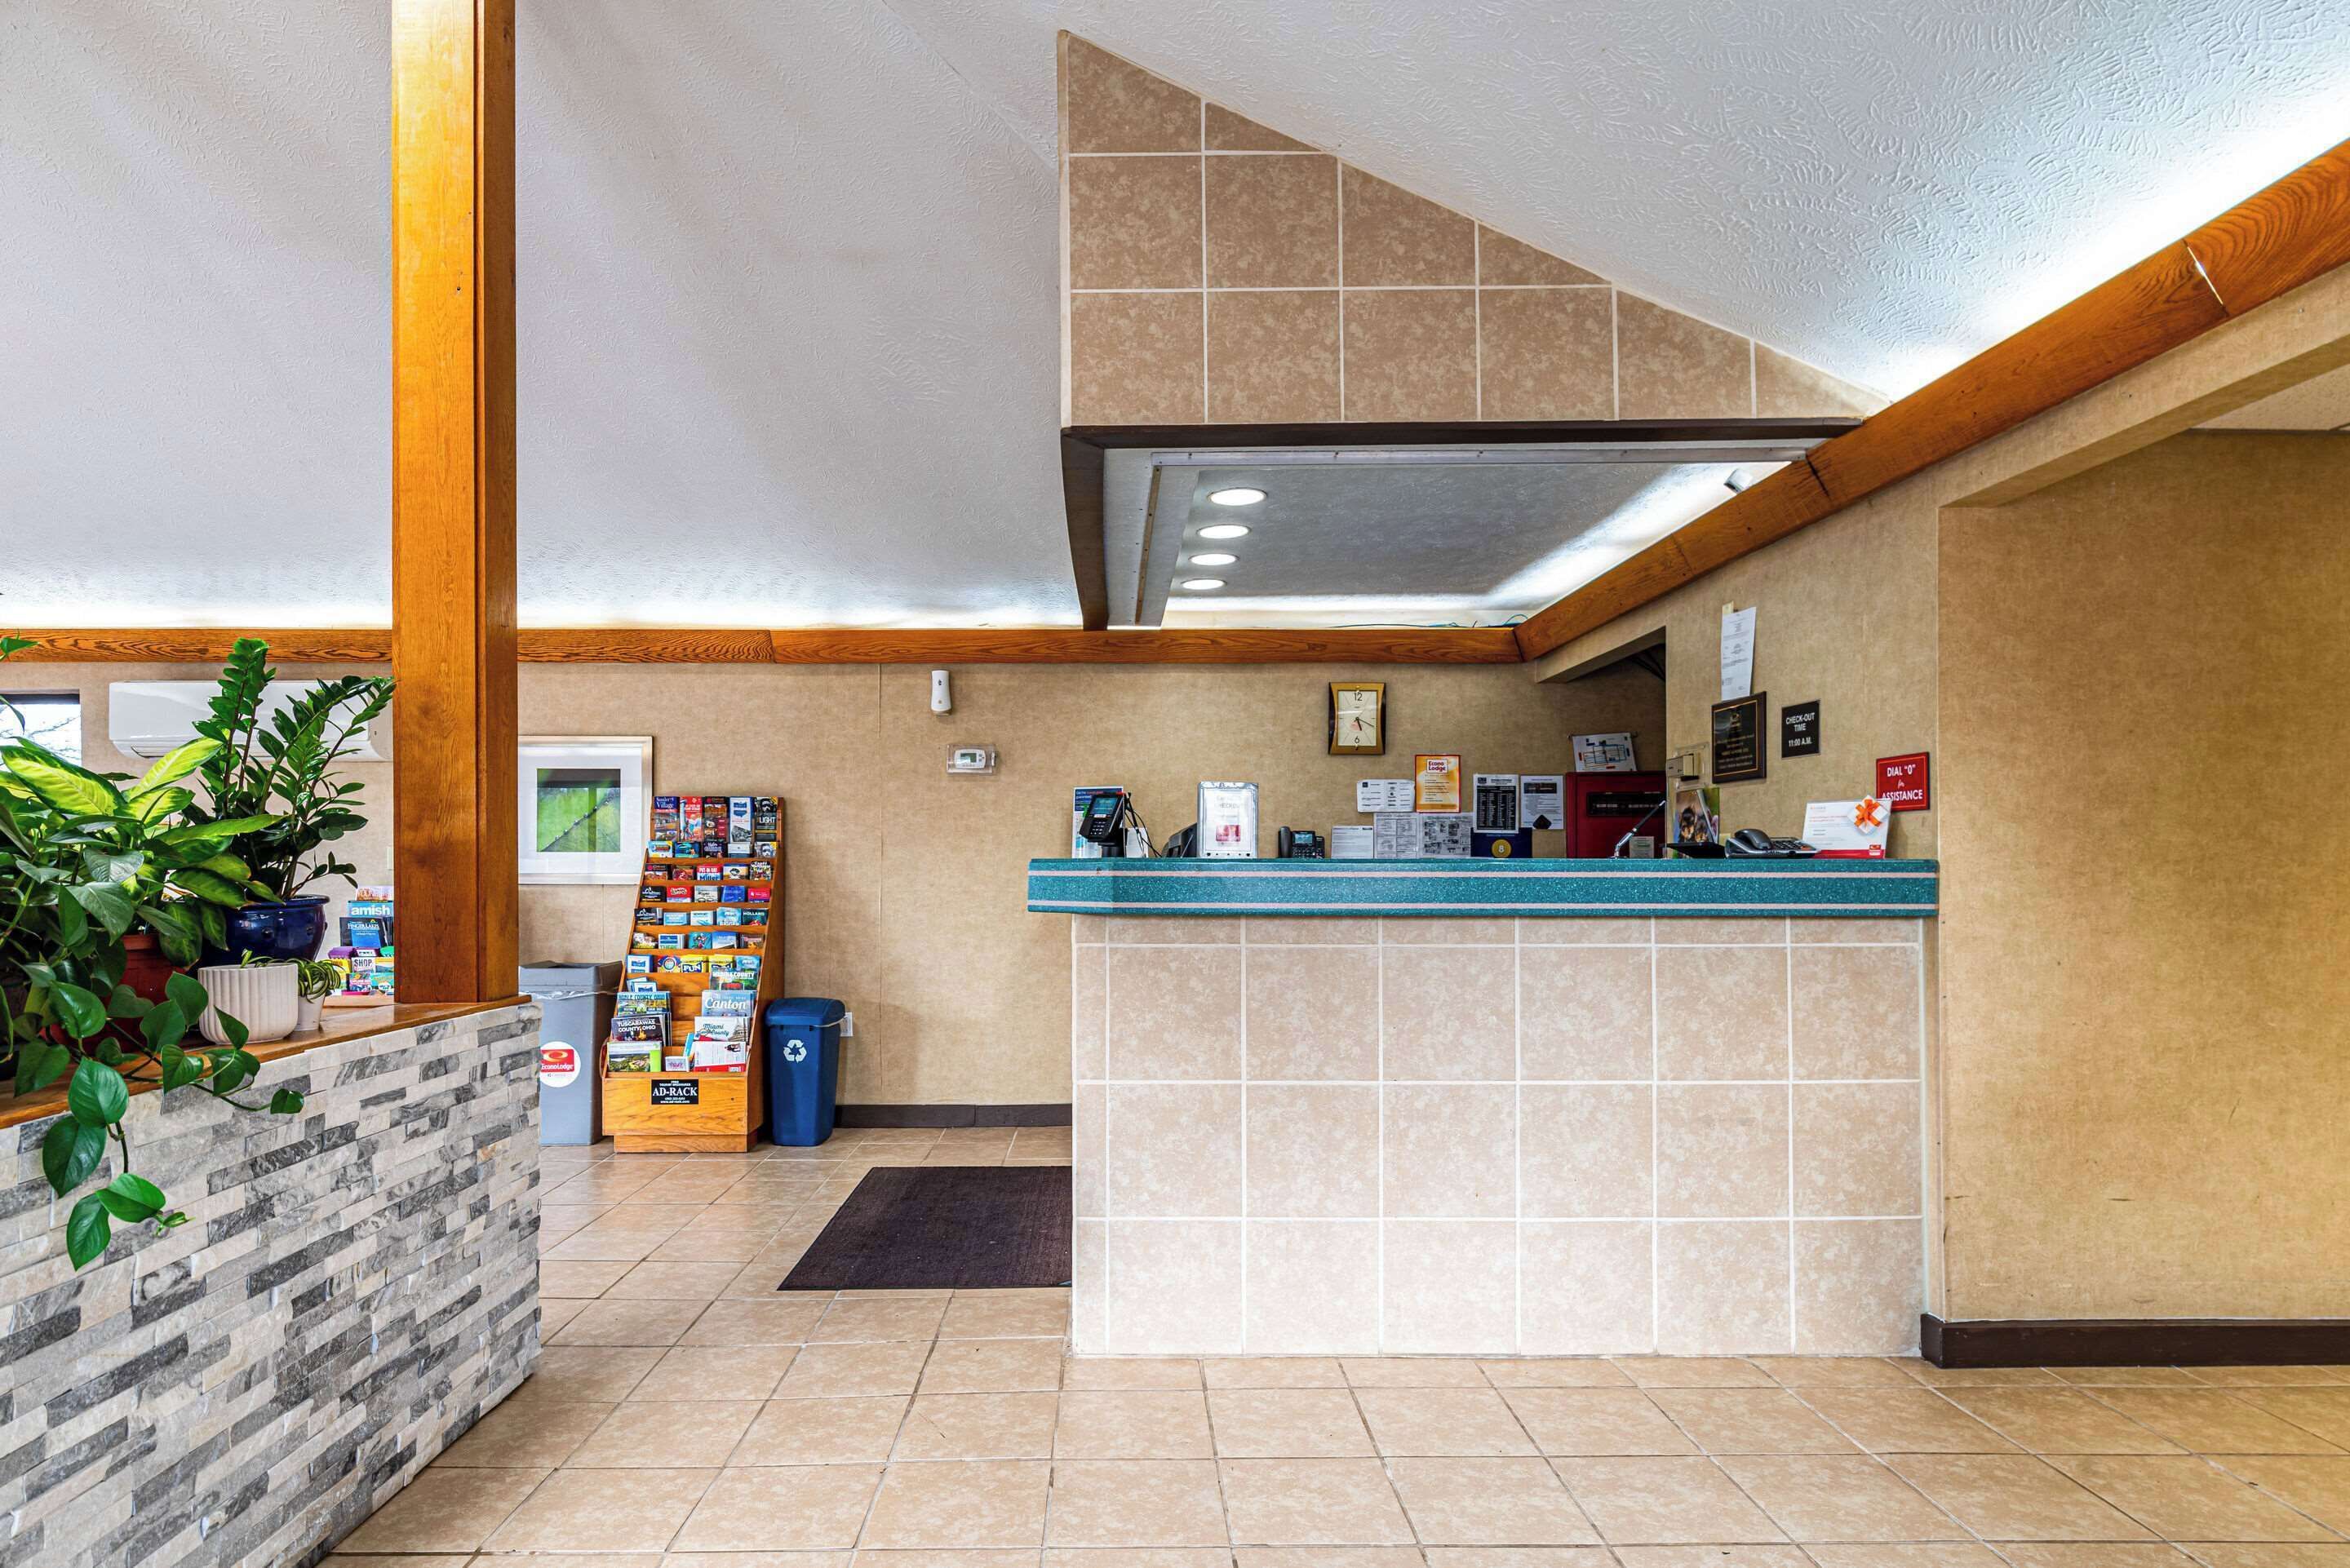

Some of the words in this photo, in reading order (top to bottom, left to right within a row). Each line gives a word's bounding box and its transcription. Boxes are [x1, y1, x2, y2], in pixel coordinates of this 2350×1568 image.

[1354, 692, 1363, 702] 12
[1785, 712, 1816, 724] CHECK-OUT
[1794, 723, 1807, 732] TIME
[1788, 737, 1801, 747] 11:00
[1801, 737, 1813, 745] A.M.
[1887, 765, 1903, 777] DIAL
[1882, 789, 1923, 801] ASSISTANCE
[351, 904, 390, 915] amish
[354, 959, 372, 968] SHOP
[704, 997, 746, 1010] Canton
[617, 1018, 656, 1027] TUSCARAWAS
[652, 1087, 698, 1096] AD-RACK
